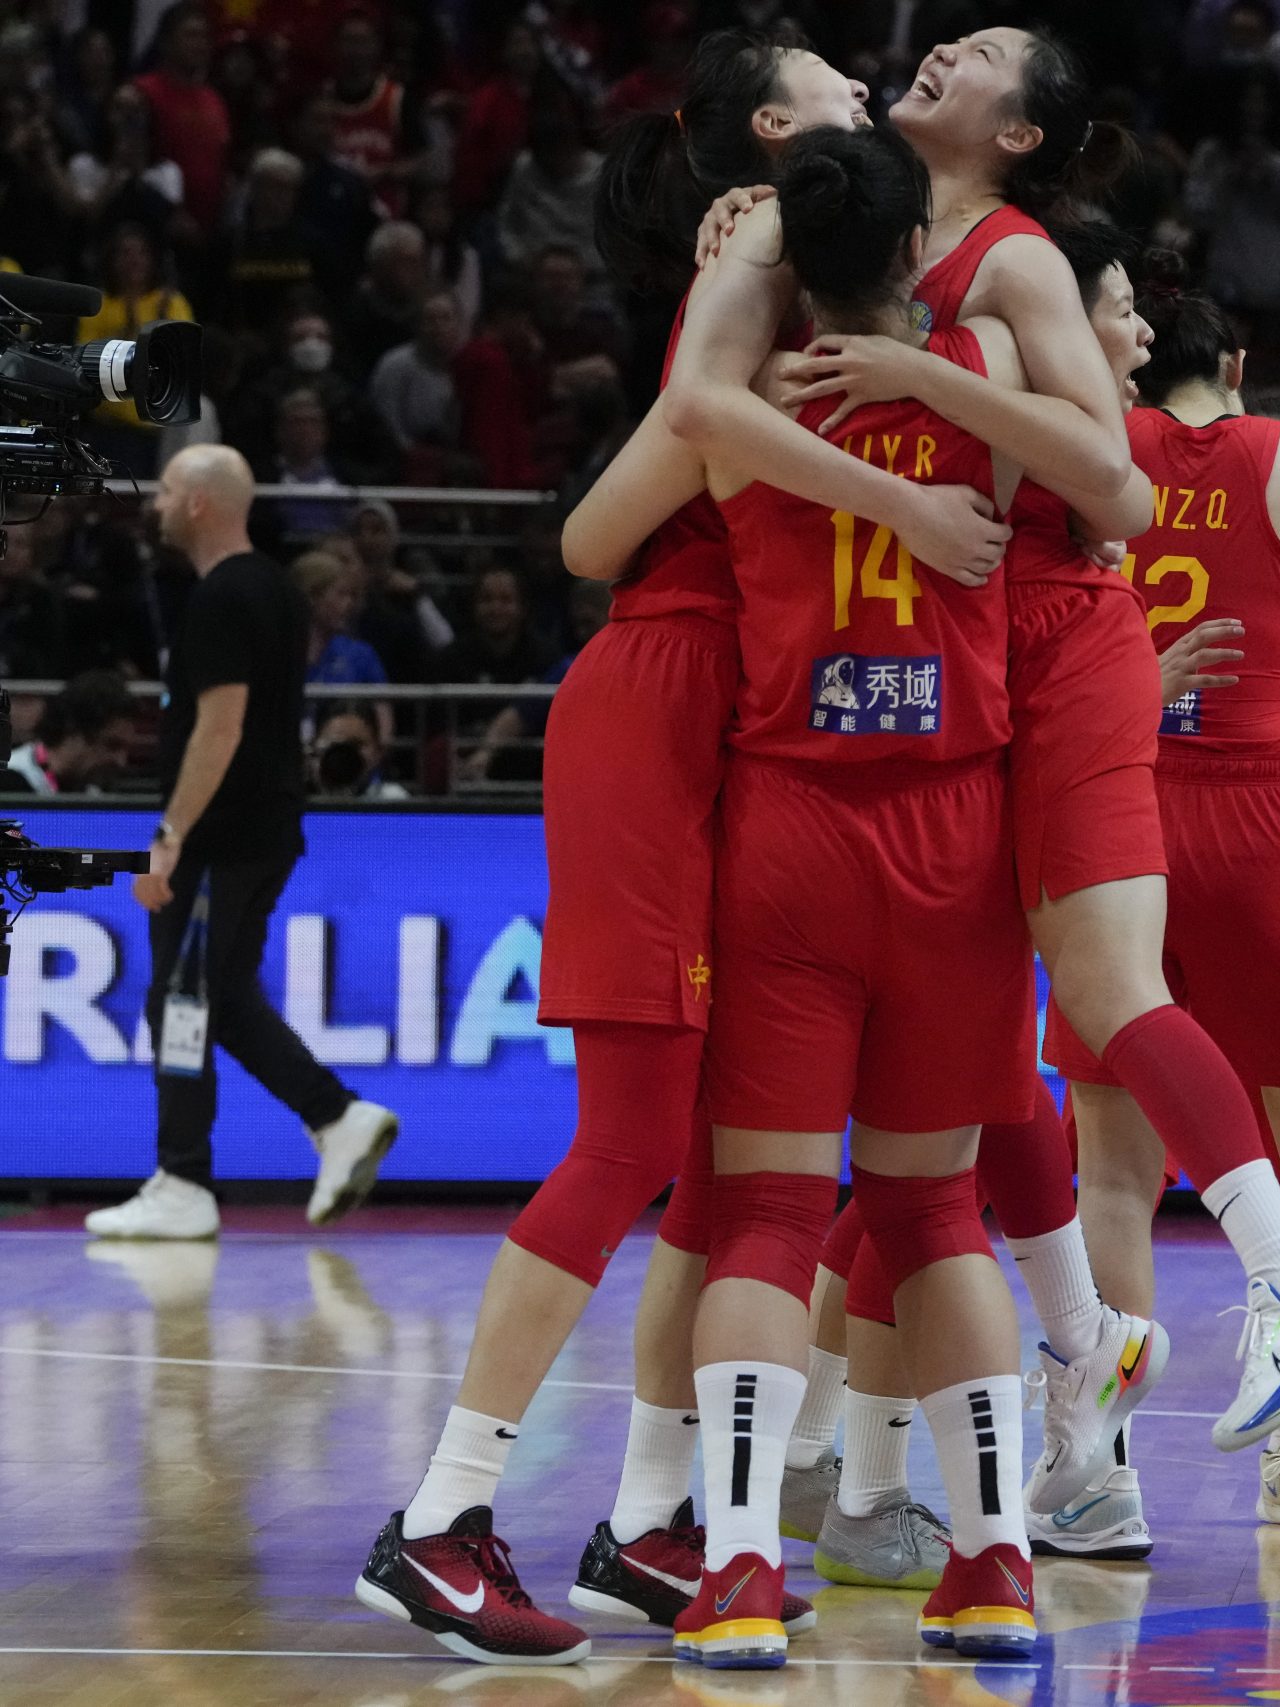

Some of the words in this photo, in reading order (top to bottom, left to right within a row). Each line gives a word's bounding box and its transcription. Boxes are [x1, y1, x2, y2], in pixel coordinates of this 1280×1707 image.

[830, 511, 922, 631] 14
[813, 709, 936, 732] 智能健康
[866, 663, 937, 710] 秀域
[3, 910, 577, 1067] RLIA
